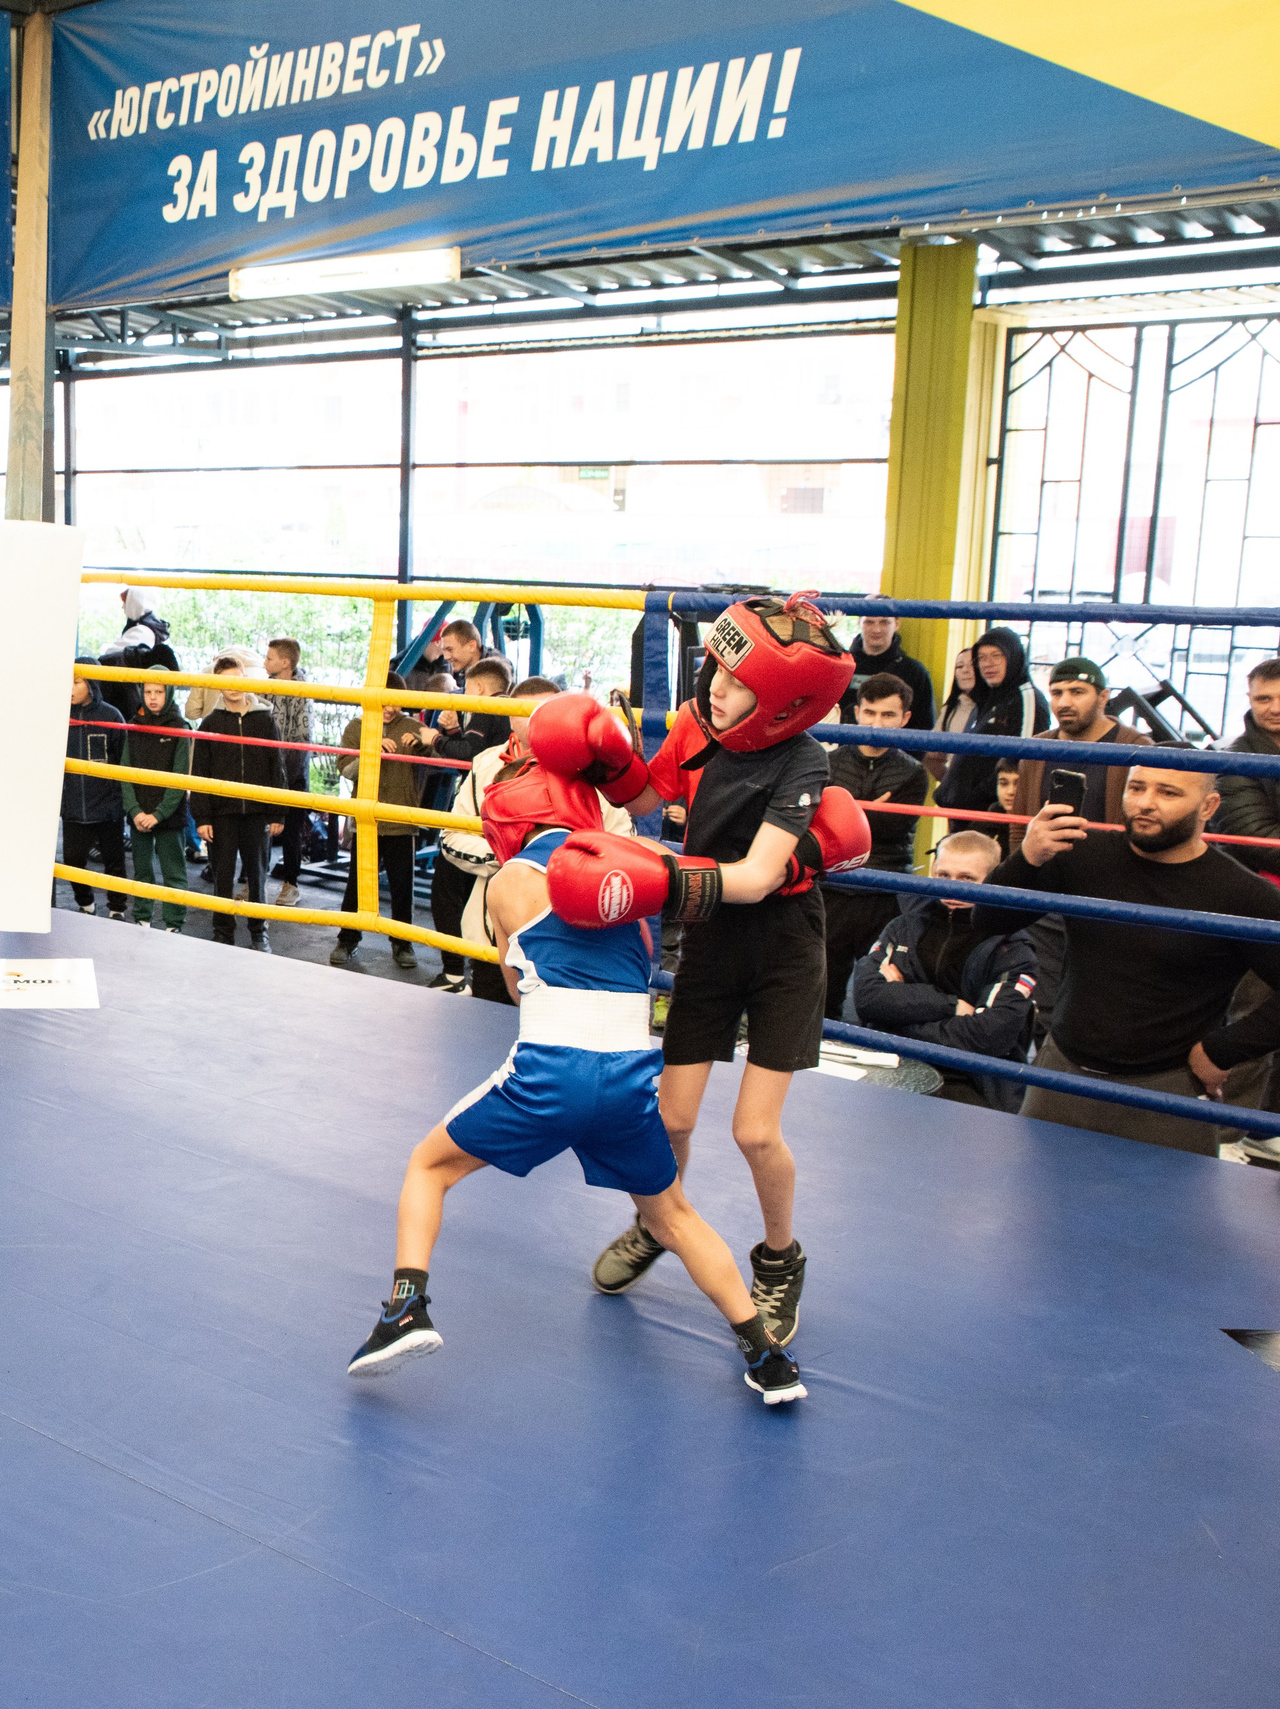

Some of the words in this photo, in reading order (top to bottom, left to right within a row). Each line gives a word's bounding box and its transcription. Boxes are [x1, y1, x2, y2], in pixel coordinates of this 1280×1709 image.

[87, 23, 446, 141] «ЮГСТРОЙИНВЕСТ»
[161, 150, 218, 224] ЗА
[232, 96, 520, 223] ЗДОРОВЬЕ
[530, 47, 803, 171] НАЦИИ!
[709, 633, 728, 658] HILL
[715, 617, 749, 656] GREEN
